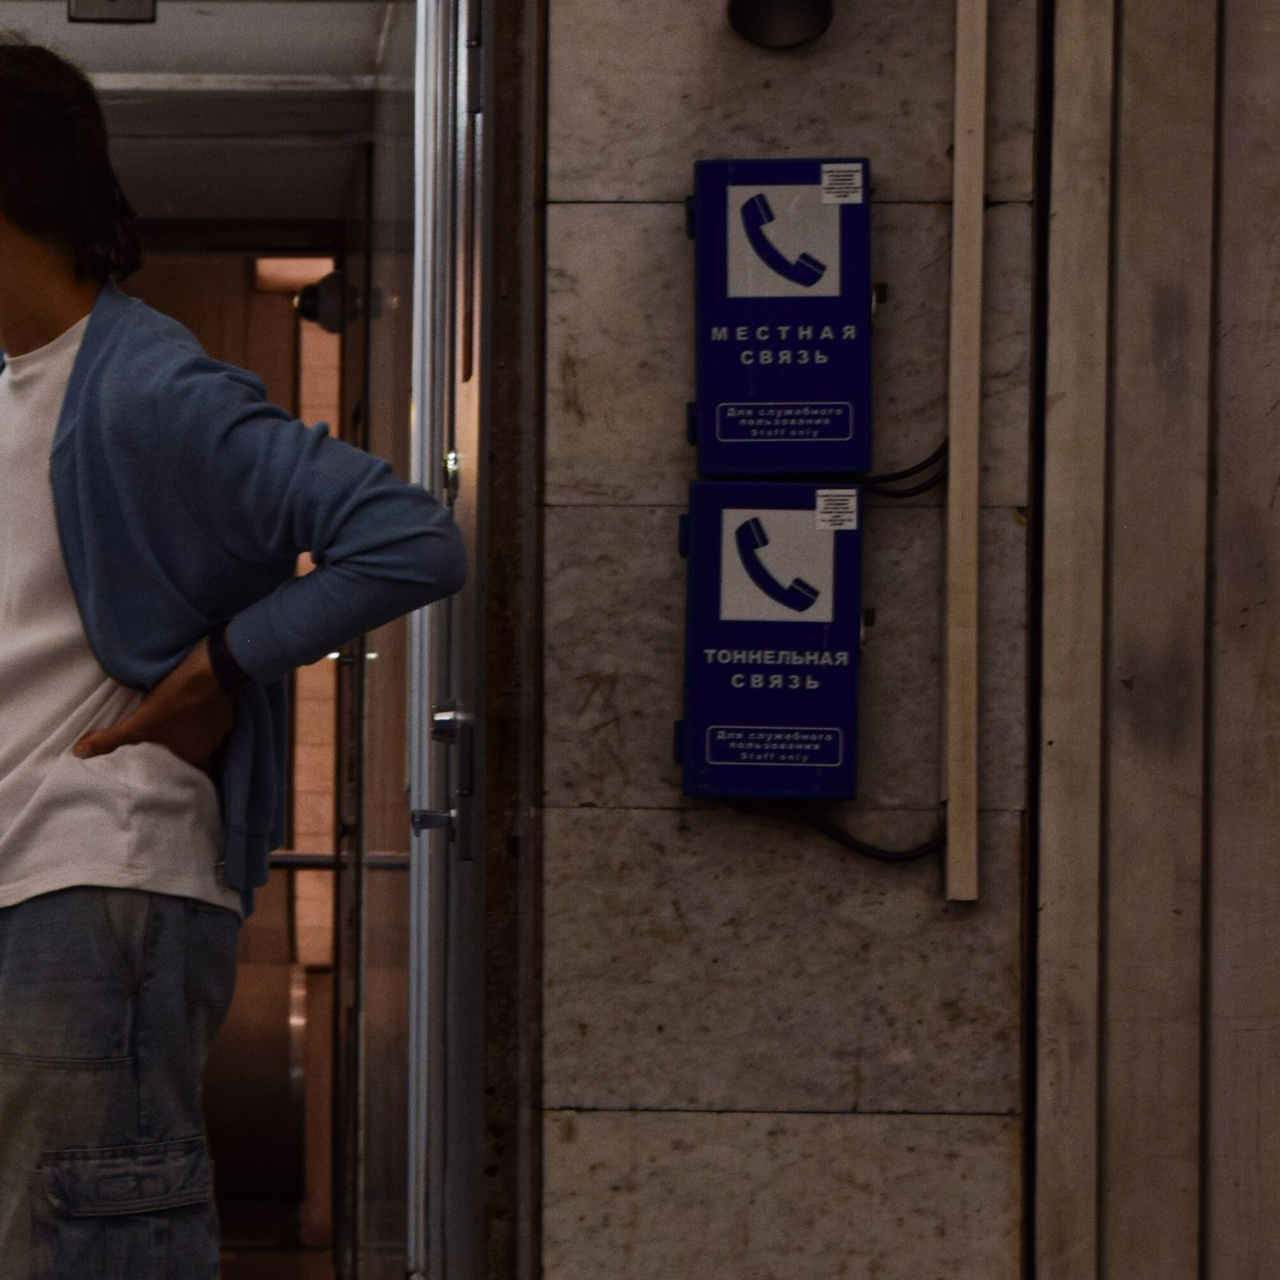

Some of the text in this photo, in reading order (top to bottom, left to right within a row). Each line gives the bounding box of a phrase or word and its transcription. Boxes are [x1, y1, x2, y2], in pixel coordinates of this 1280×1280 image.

[711, 325, 857, 341] МЕСТНАЯ
[740, 350, 829, 365] СВЯЗЬ
[726, 406, 844, 418] Для служебного
[738, 417, 831, 426] пользования
[750, 428, 820, 438] Staff only
[703, 648, 850, 666] ТОННЕЛЬНАЯ
[730, 674, 820, 689] СВЯЗЬ
[716, 730, 834, 742] Для служебного
[728, 742, 821, 751] пользования
[740, 752, 810, 762] Staff only
